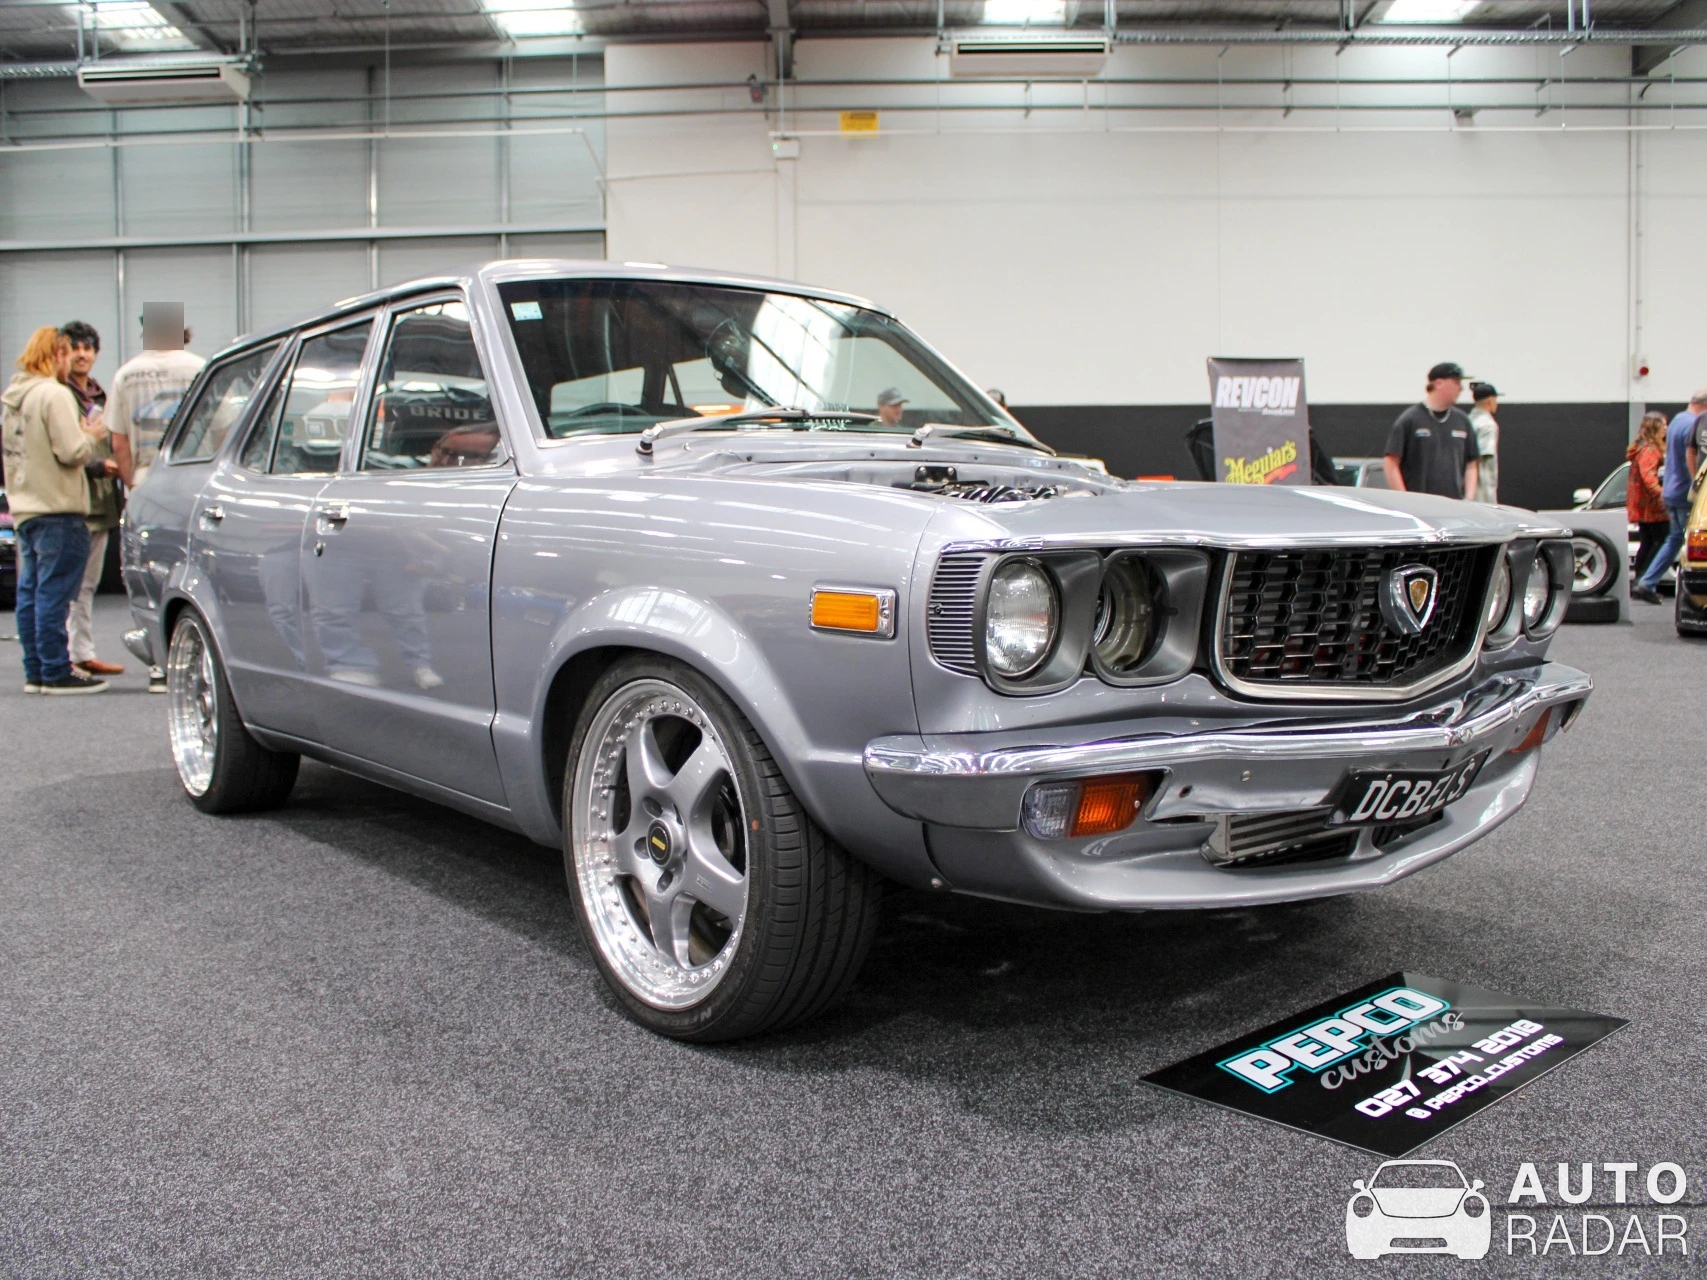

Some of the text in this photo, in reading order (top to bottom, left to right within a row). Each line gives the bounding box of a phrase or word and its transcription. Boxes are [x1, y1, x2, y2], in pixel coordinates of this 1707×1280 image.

[410, 405, 488, 420] BRIDE
[1215, 376, 1300, 408] REVCON
[1224, 440, 1297, 484] Meguiar's
[1350, 762, 1475, 821] DCBELS
[1219, 987, 1448, 1091] PEPCO
[1320, 1011, 1465, 1090] customs
[1355, 1019, 1544, 1117] 027 374 2018
[1424, 1033, 1564, 1110] PEPCO_CUSTOMS
